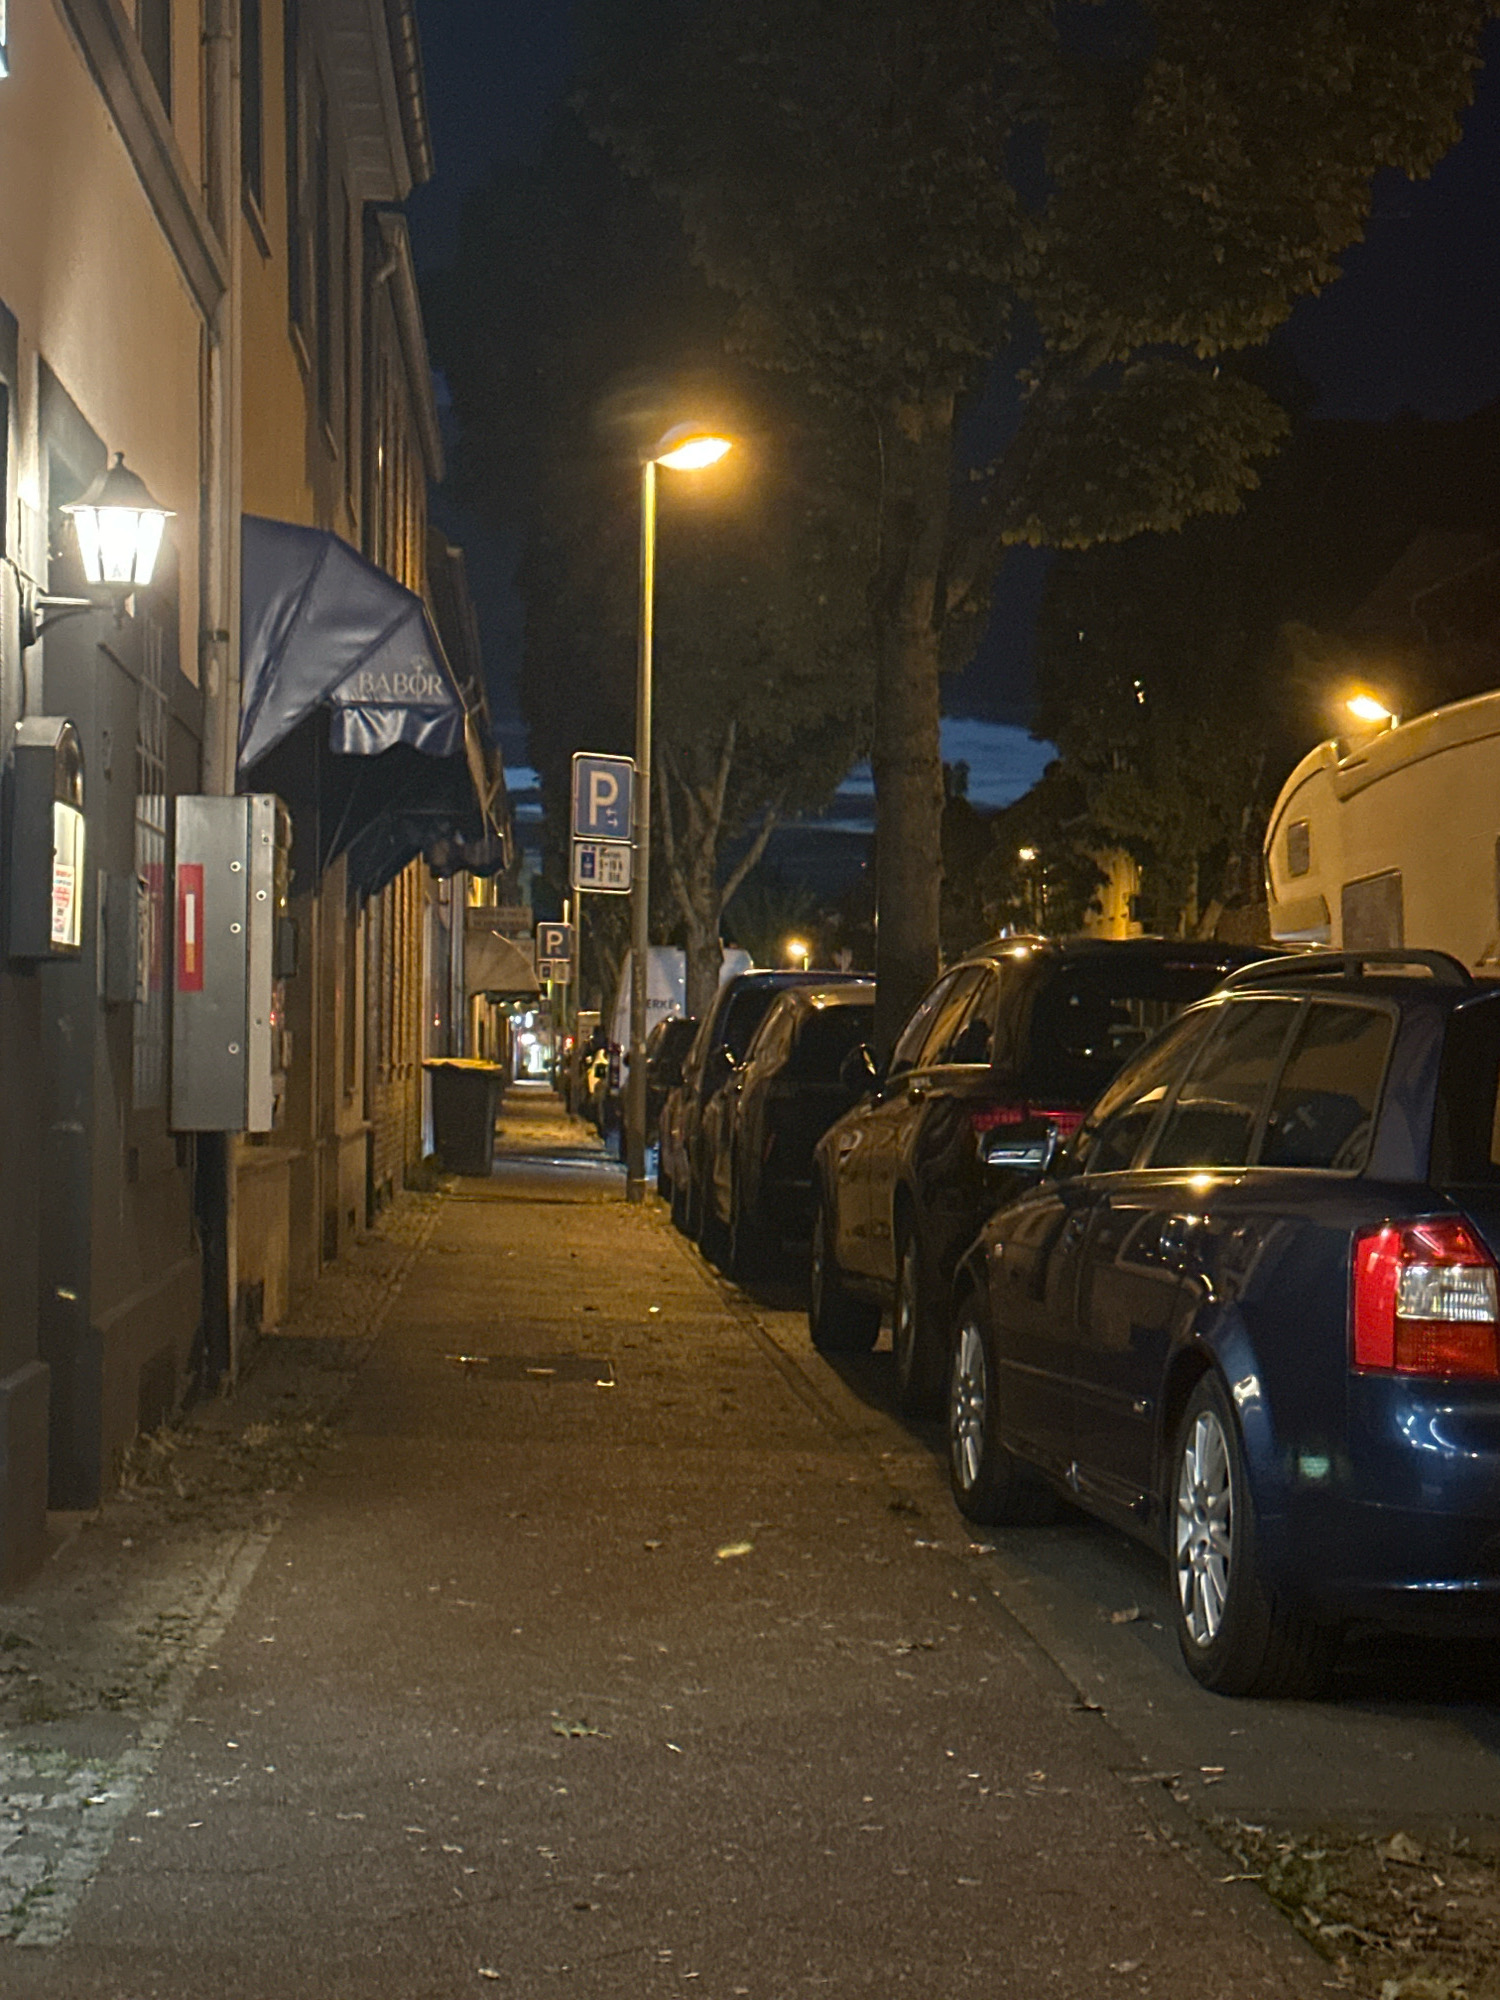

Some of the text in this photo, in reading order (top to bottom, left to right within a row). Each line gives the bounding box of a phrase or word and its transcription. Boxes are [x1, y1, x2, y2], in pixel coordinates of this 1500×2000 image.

[359, 668, 443, 698] BABOR
[589, 770, 619, 826] P
[546, 930, 563, 955] P
